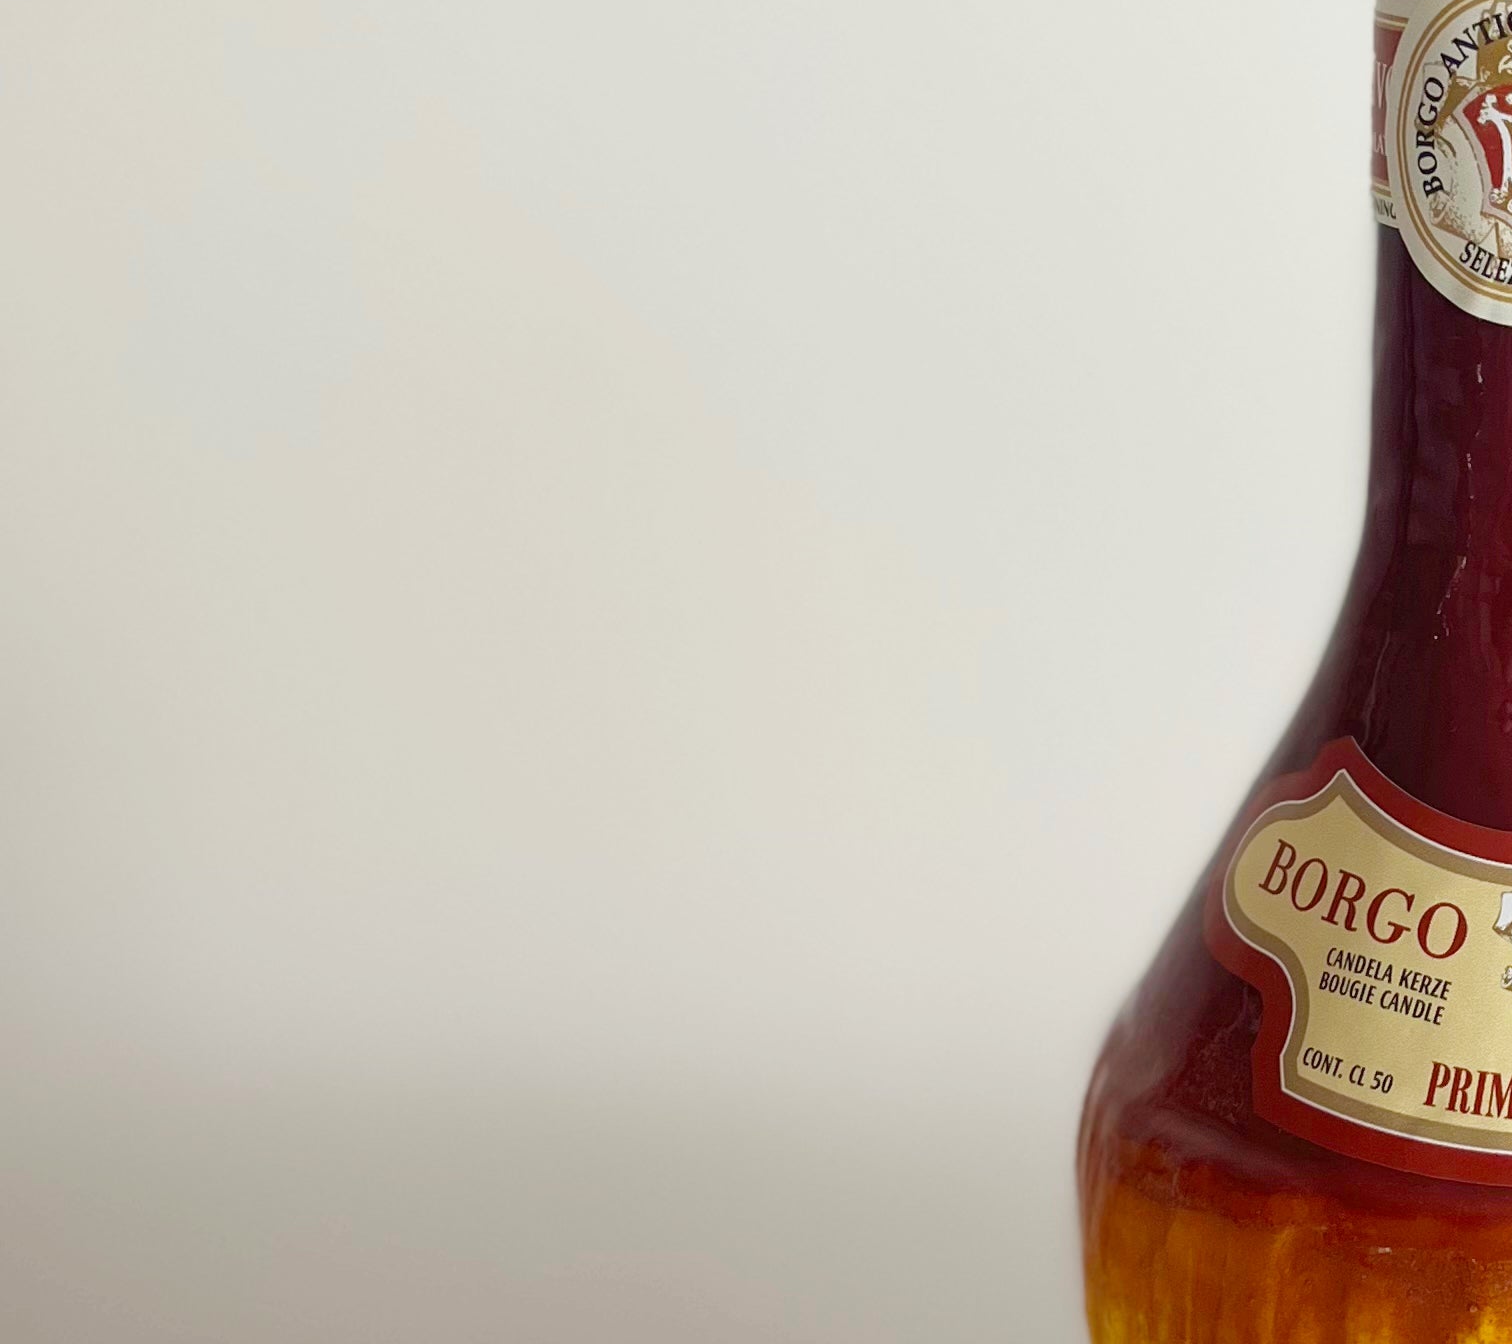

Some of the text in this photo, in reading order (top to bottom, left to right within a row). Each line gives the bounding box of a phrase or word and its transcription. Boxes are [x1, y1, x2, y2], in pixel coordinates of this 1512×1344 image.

[1416, 76, 1444, 198] BORGO
[1258, 839, 1469, 959] BORGO
[1318, 971, 1446, 1025] BOUGIE CANDLE
[1325, 947, 1453, 1000] CANDELA KERZE
[1302, 1046, 1395, 1095] CONT. CL 50
